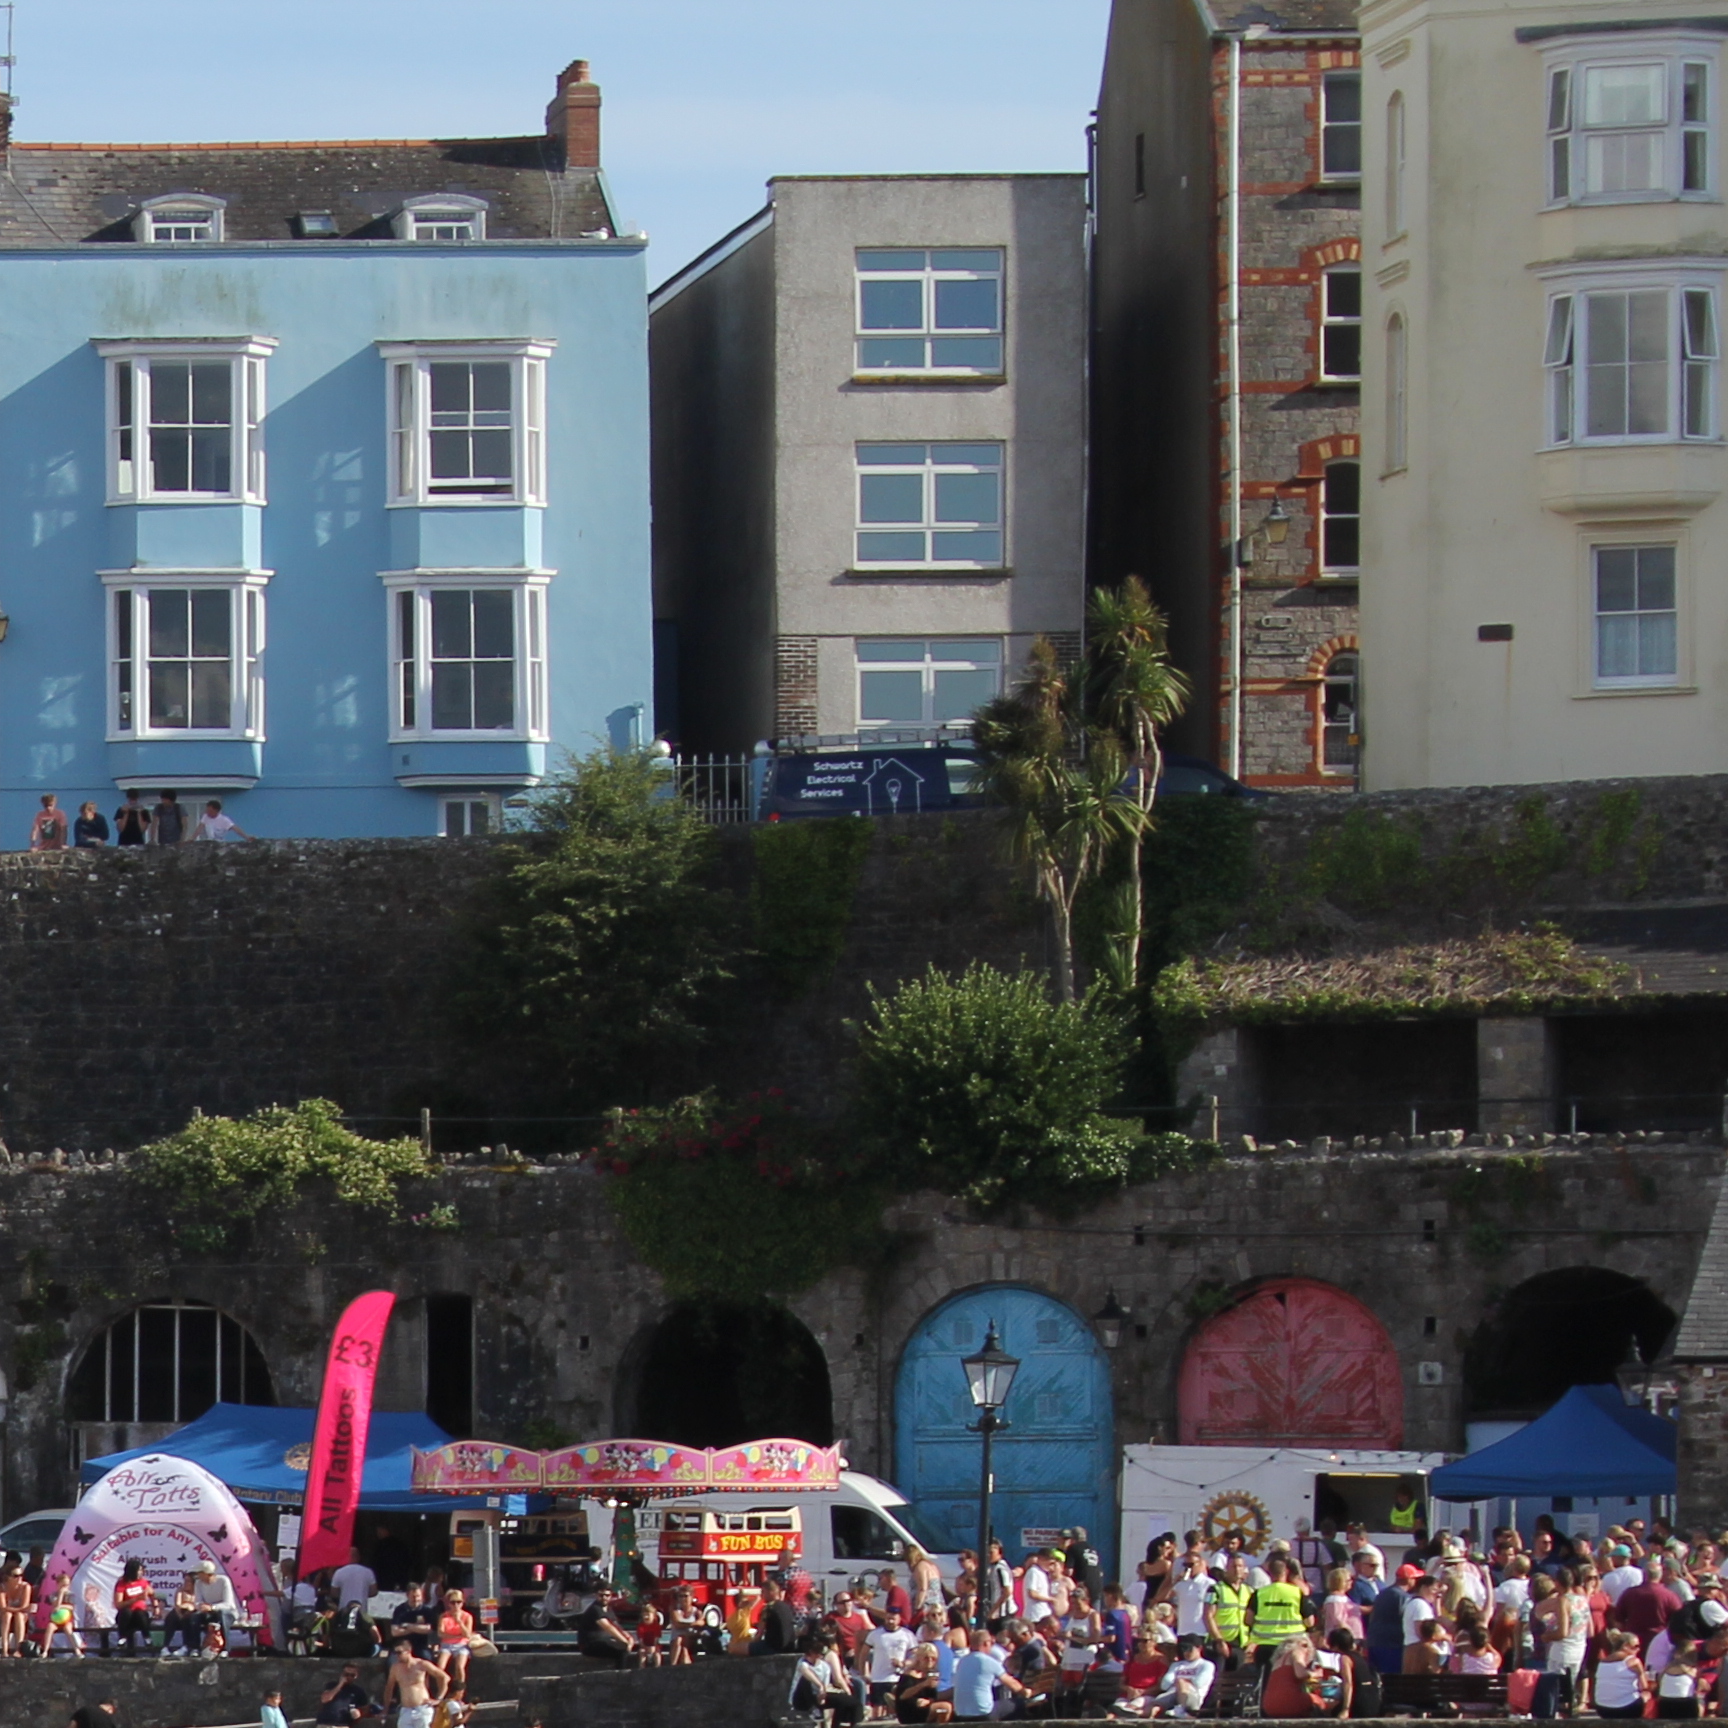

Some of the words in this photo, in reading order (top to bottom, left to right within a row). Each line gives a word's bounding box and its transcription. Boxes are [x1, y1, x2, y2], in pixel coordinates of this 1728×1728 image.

[813, 761, 864, 771] Schwartz
[806, 774, 856, 785] Electrical
[800, 788, 844, 798] Services
[334, 1335, 374, 1369] £3
[325, 1386, 358, 1487] Tattoos
[106, 1468, 155, 1489] Air
[126, 1483, 202, 1509] Tatts
[275, 1490, 303, 1503] Club
[320, 1497, 343, 1535] All
[90, 1527, 141, 1564] Suitable
[143, 1526, 164, 1538] for
[166, 1528, 194, 1548] Any
[720, 1535, 751, 1551] FUN
[754, 1534, 784, 1550] BUS
[142, 1569, 188, 1581] mporary
[147, 1579, 183, 1589] Tattoo
